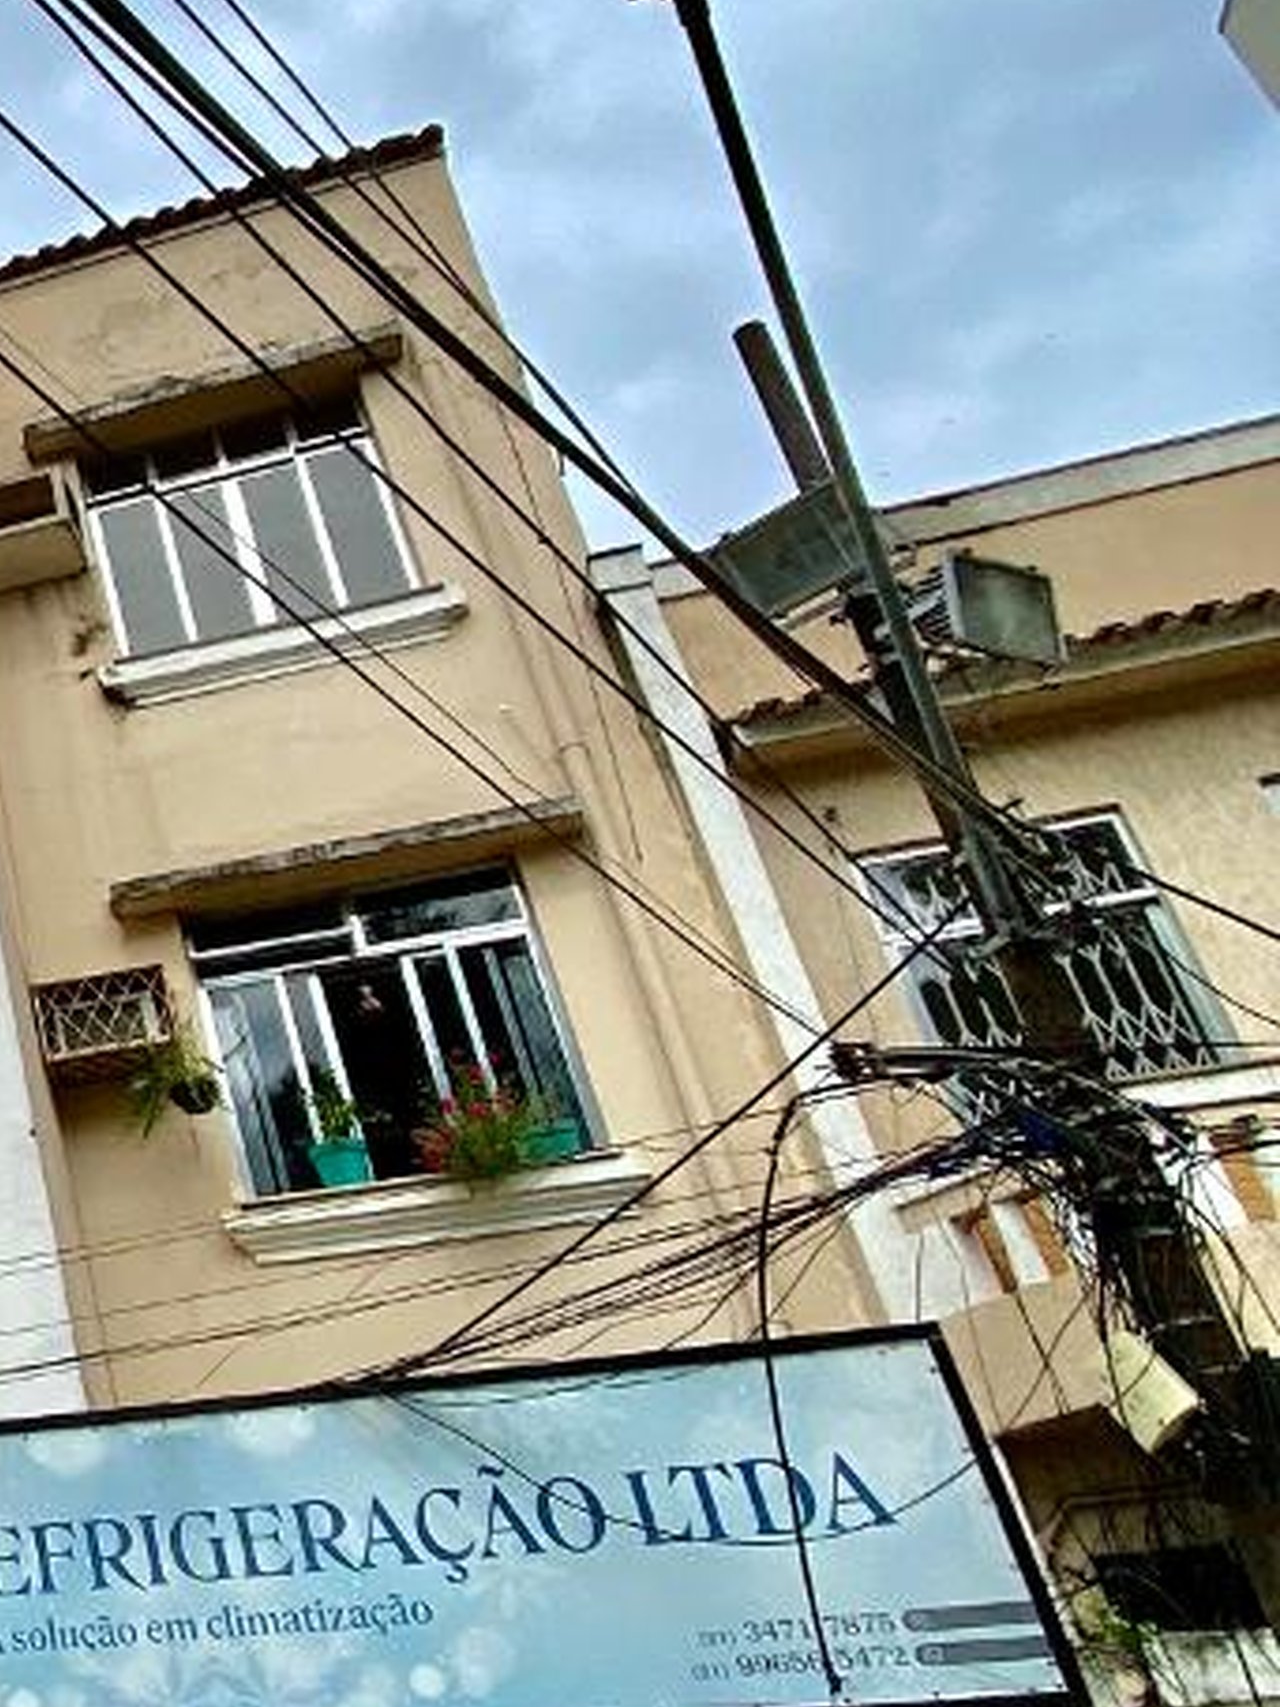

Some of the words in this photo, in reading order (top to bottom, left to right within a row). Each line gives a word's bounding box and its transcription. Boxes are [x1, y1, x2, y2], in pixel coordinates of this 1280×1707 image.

[624, 1451, 898, 1545] LTDA
[12, 1614, 140, 1653] solução
[145, 1614, 199, 1646] em
[205, 1593, 436, 1642] climatização
